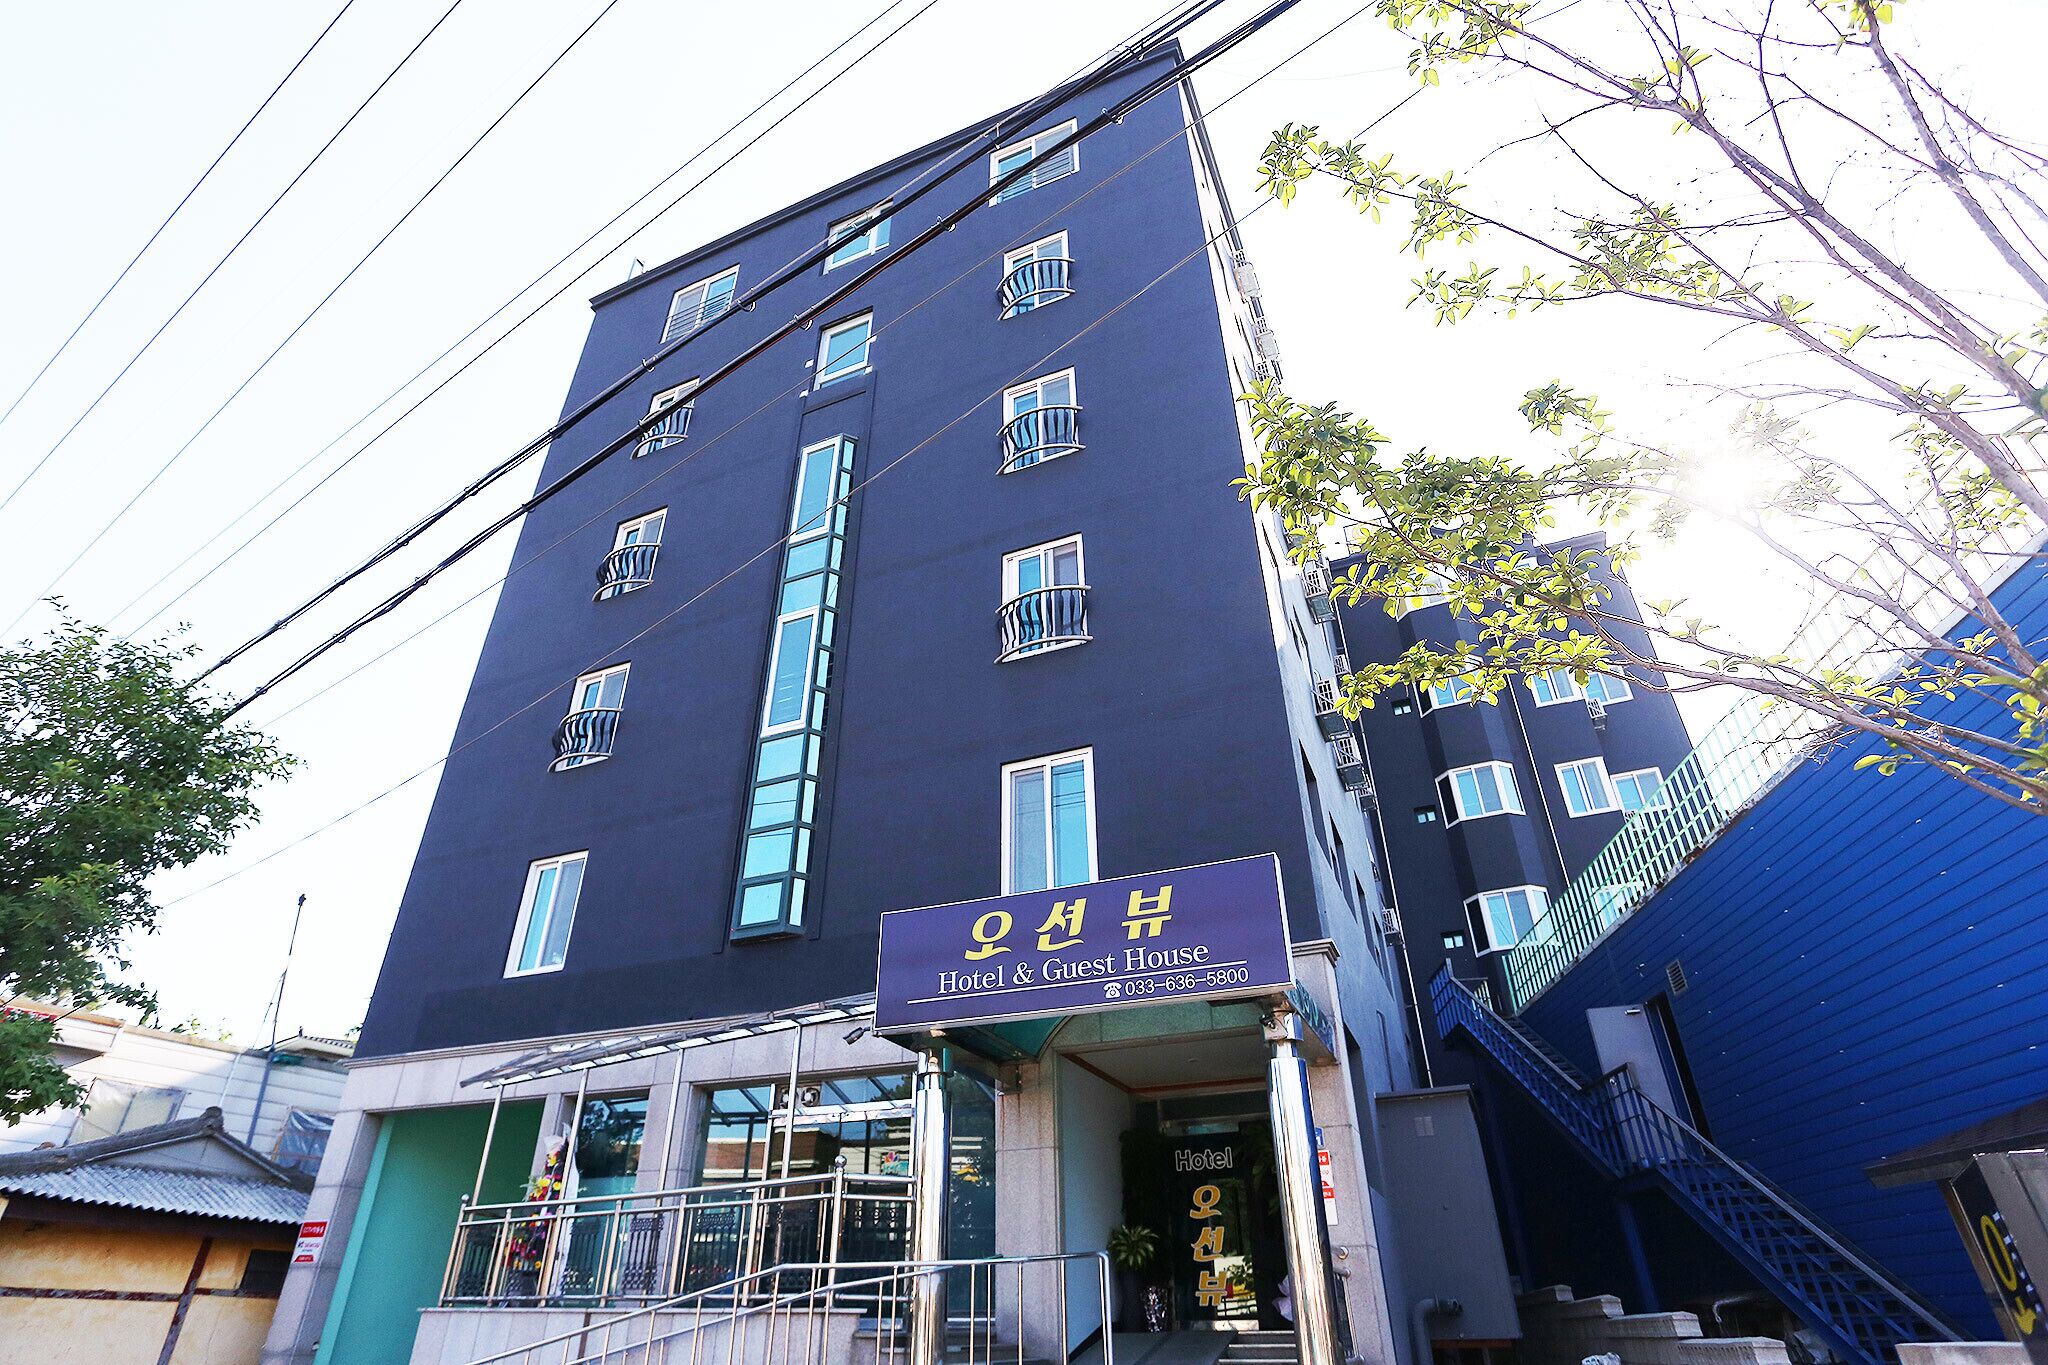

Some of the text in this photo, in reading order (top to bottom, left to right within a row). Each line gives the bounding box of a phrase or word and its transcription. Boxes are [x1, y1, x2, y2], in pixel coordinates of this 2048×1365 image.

[964, 885, 1173, 961] 오션뷰
[937, 944, 1210, 994] Hotel & Guest House
[1124, 967, 1250, 997] 033-636-5800
[1175, 1147, 1233, 1171] Hotel
